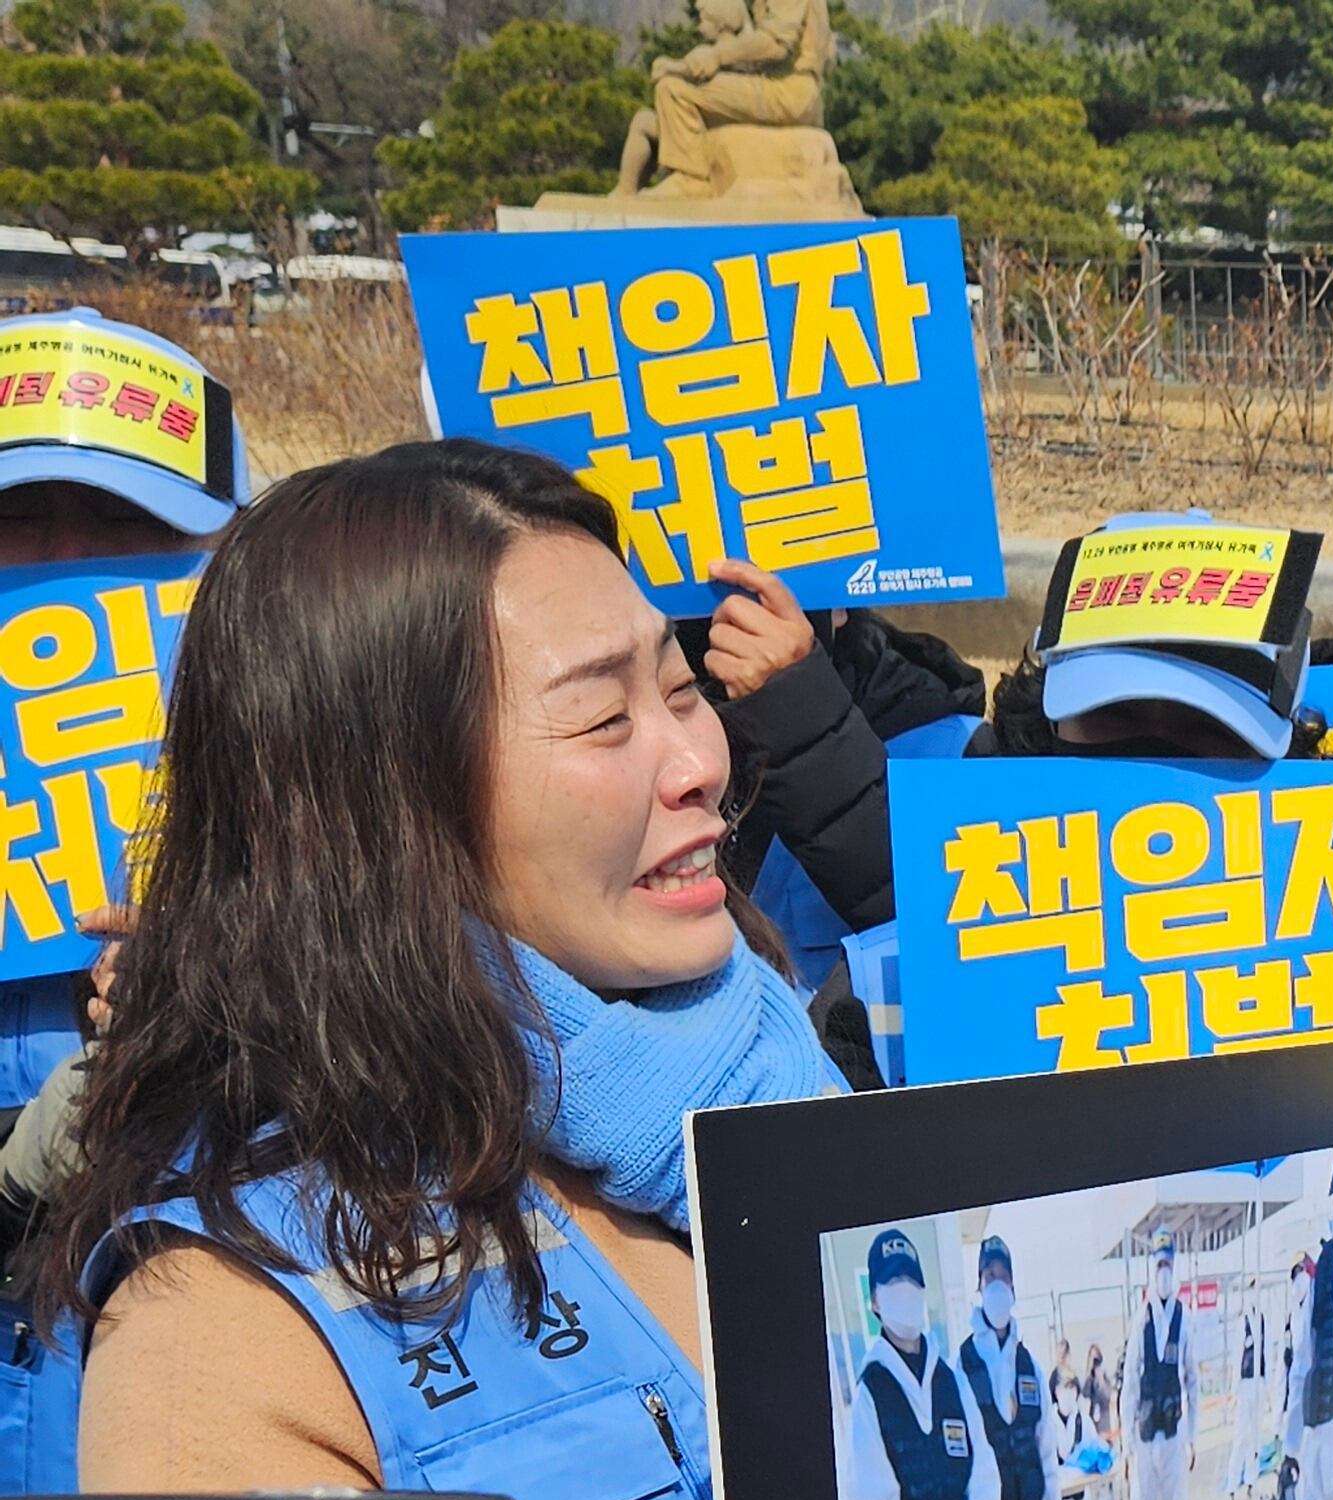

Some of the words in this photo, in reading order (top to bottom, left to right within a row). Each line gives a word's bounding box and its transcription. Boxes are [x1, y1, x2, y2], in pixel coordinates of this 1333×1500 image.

[465, 228, 931, 441] 책임자
[58, 371, 199, 443] 유류품
[574, 405, 881, 585] 처벌
[1066, 571, 1153, 612] 은폐된
[1150, 566, 1275, 609] 유류품
